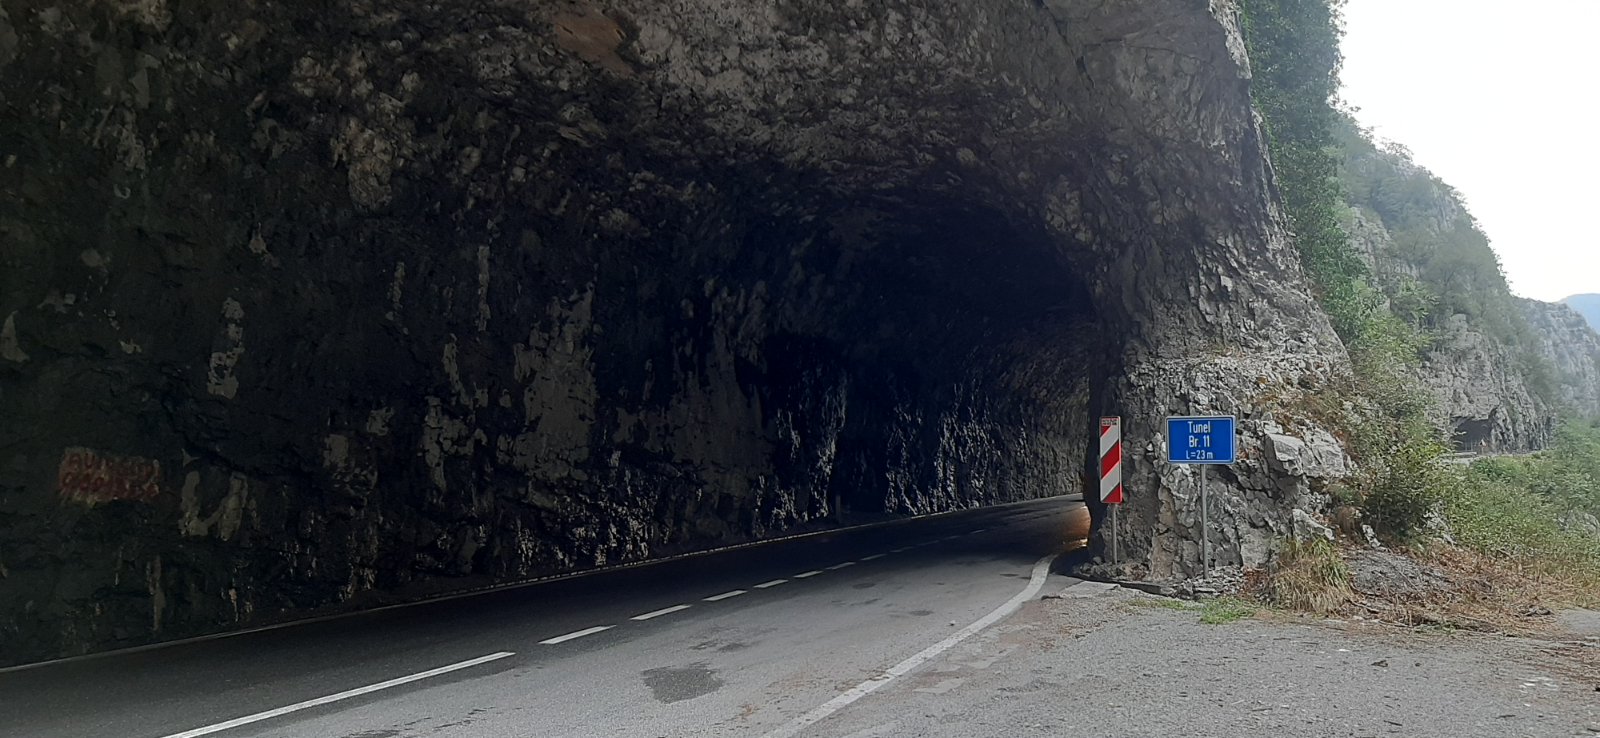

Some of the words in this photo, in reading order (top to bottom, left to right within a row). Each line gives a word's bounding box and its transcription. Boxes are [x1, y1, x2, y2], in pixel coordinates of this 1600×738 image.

[1187, 421, 1211, 433] Tunel
[1188, 435, 1201, 448] Br.
[1203, 435, 1210, 448] 11
